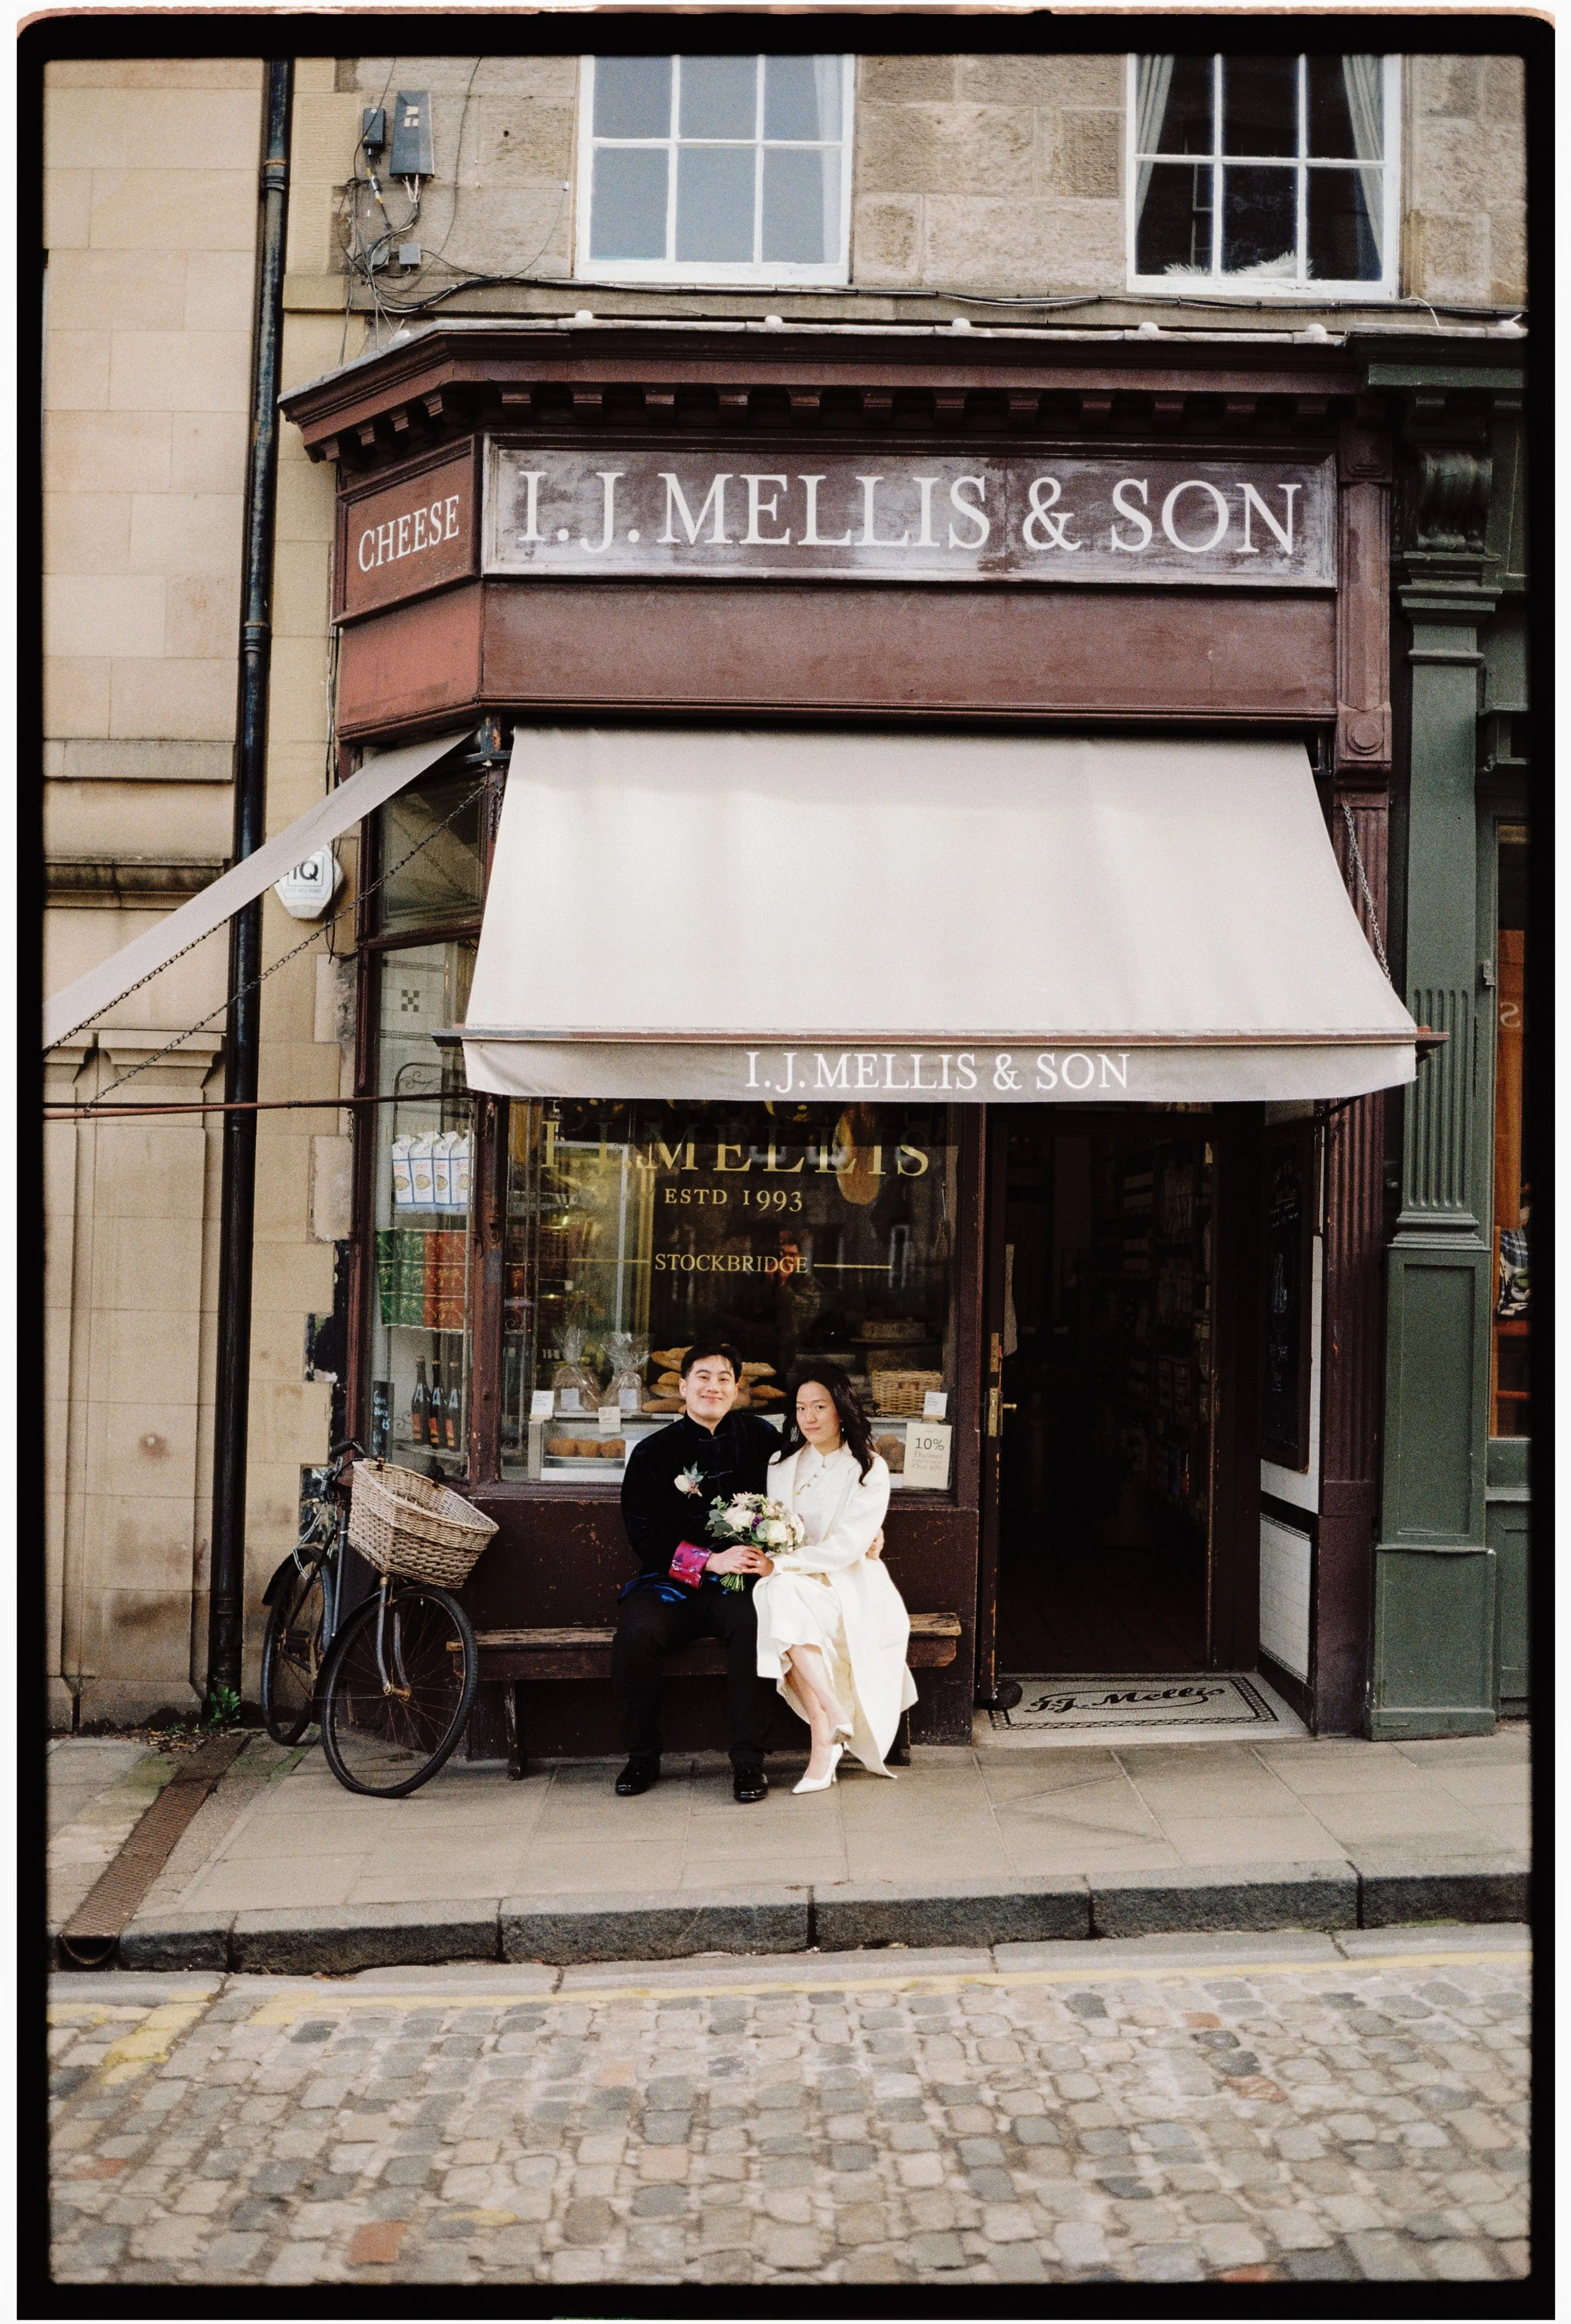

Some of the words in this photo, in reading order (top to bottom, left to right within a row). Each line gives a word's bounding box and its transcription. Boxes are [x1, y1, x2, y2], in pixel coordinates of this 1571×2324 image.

[657, 473, 990, 549] MELLIS
[1022, 476, 1082, 551] &
[1112, 478, 1302, 556] SON
[358, 495, 460, 573] CHEESE
[993, 1053, 1022, 1090] &
[1036, 1053, 1130, 1089] SON
[644, 1122, 929, 1176] MELLIS
[664, 1188, 727, 1205] ESTD
[743, 1190, 802, 1212] 1993
[655, 1253, 807, 1274] STOCKBRIDGE
[915, 1437, 944, 1451] 10%
[1092, 1687, 1225, 1706] Mellis
